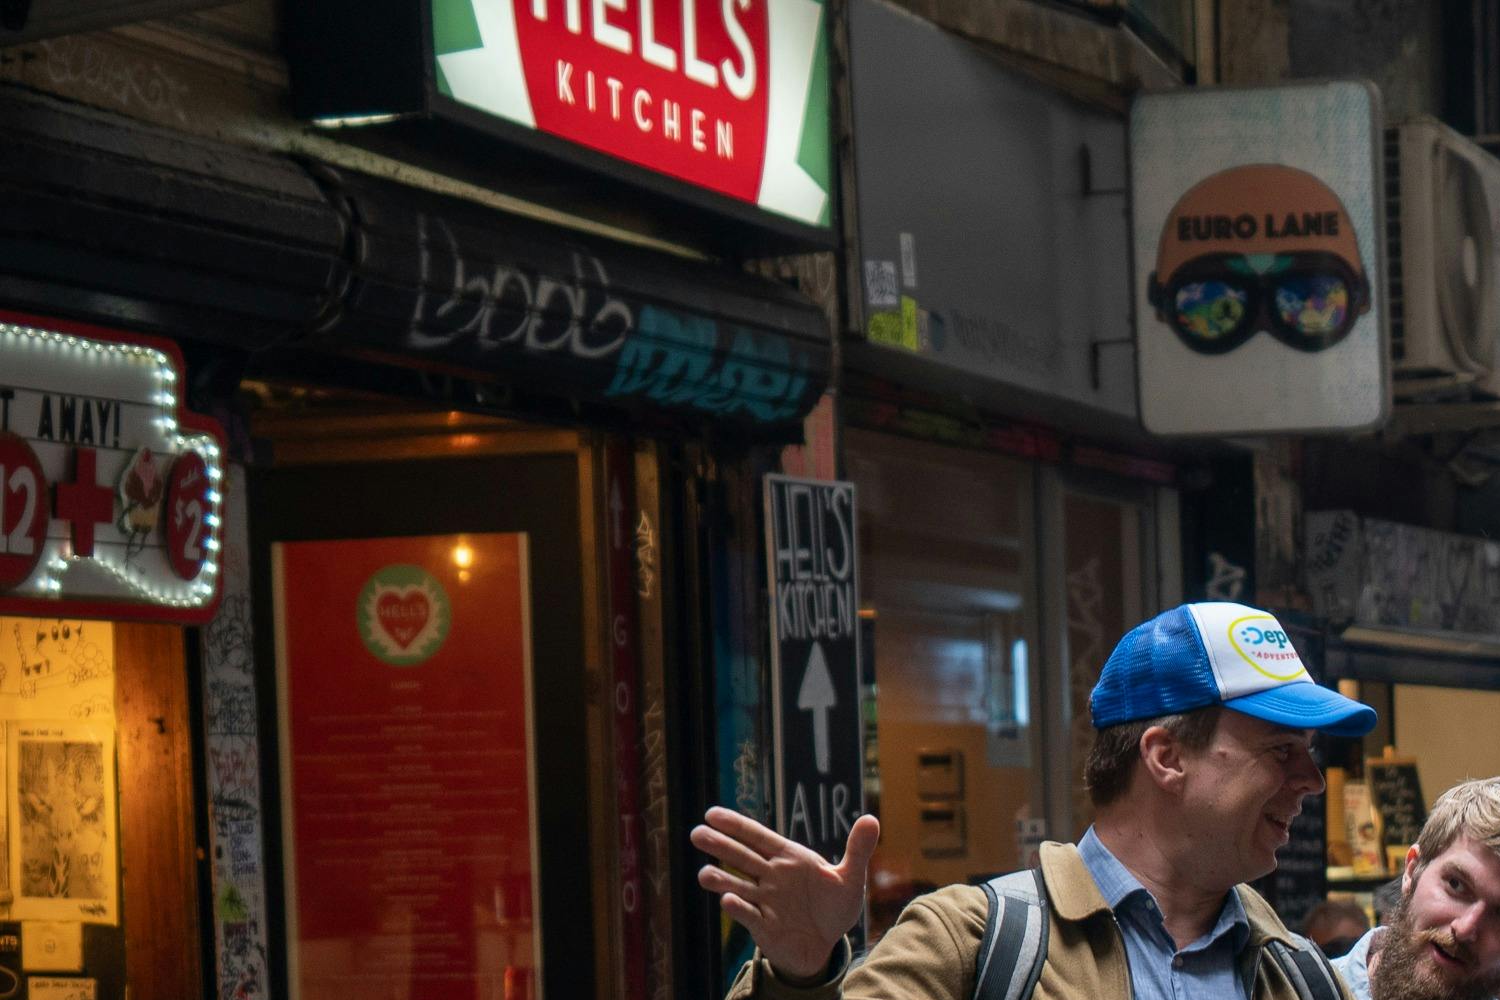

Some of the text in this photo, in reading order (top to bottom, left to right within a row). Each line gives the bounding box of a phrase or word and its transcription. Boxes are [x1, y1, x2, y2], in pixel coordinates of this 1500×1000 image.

[556, 59, 734, 160] KITCHEN
[1177, 211, 1340, 242] EURO LANE
[38, 395, 120, 448] AWAY!
[770, 482, 852, 581] HELL'S
[776, 580, 853, 641] KITCHEN
